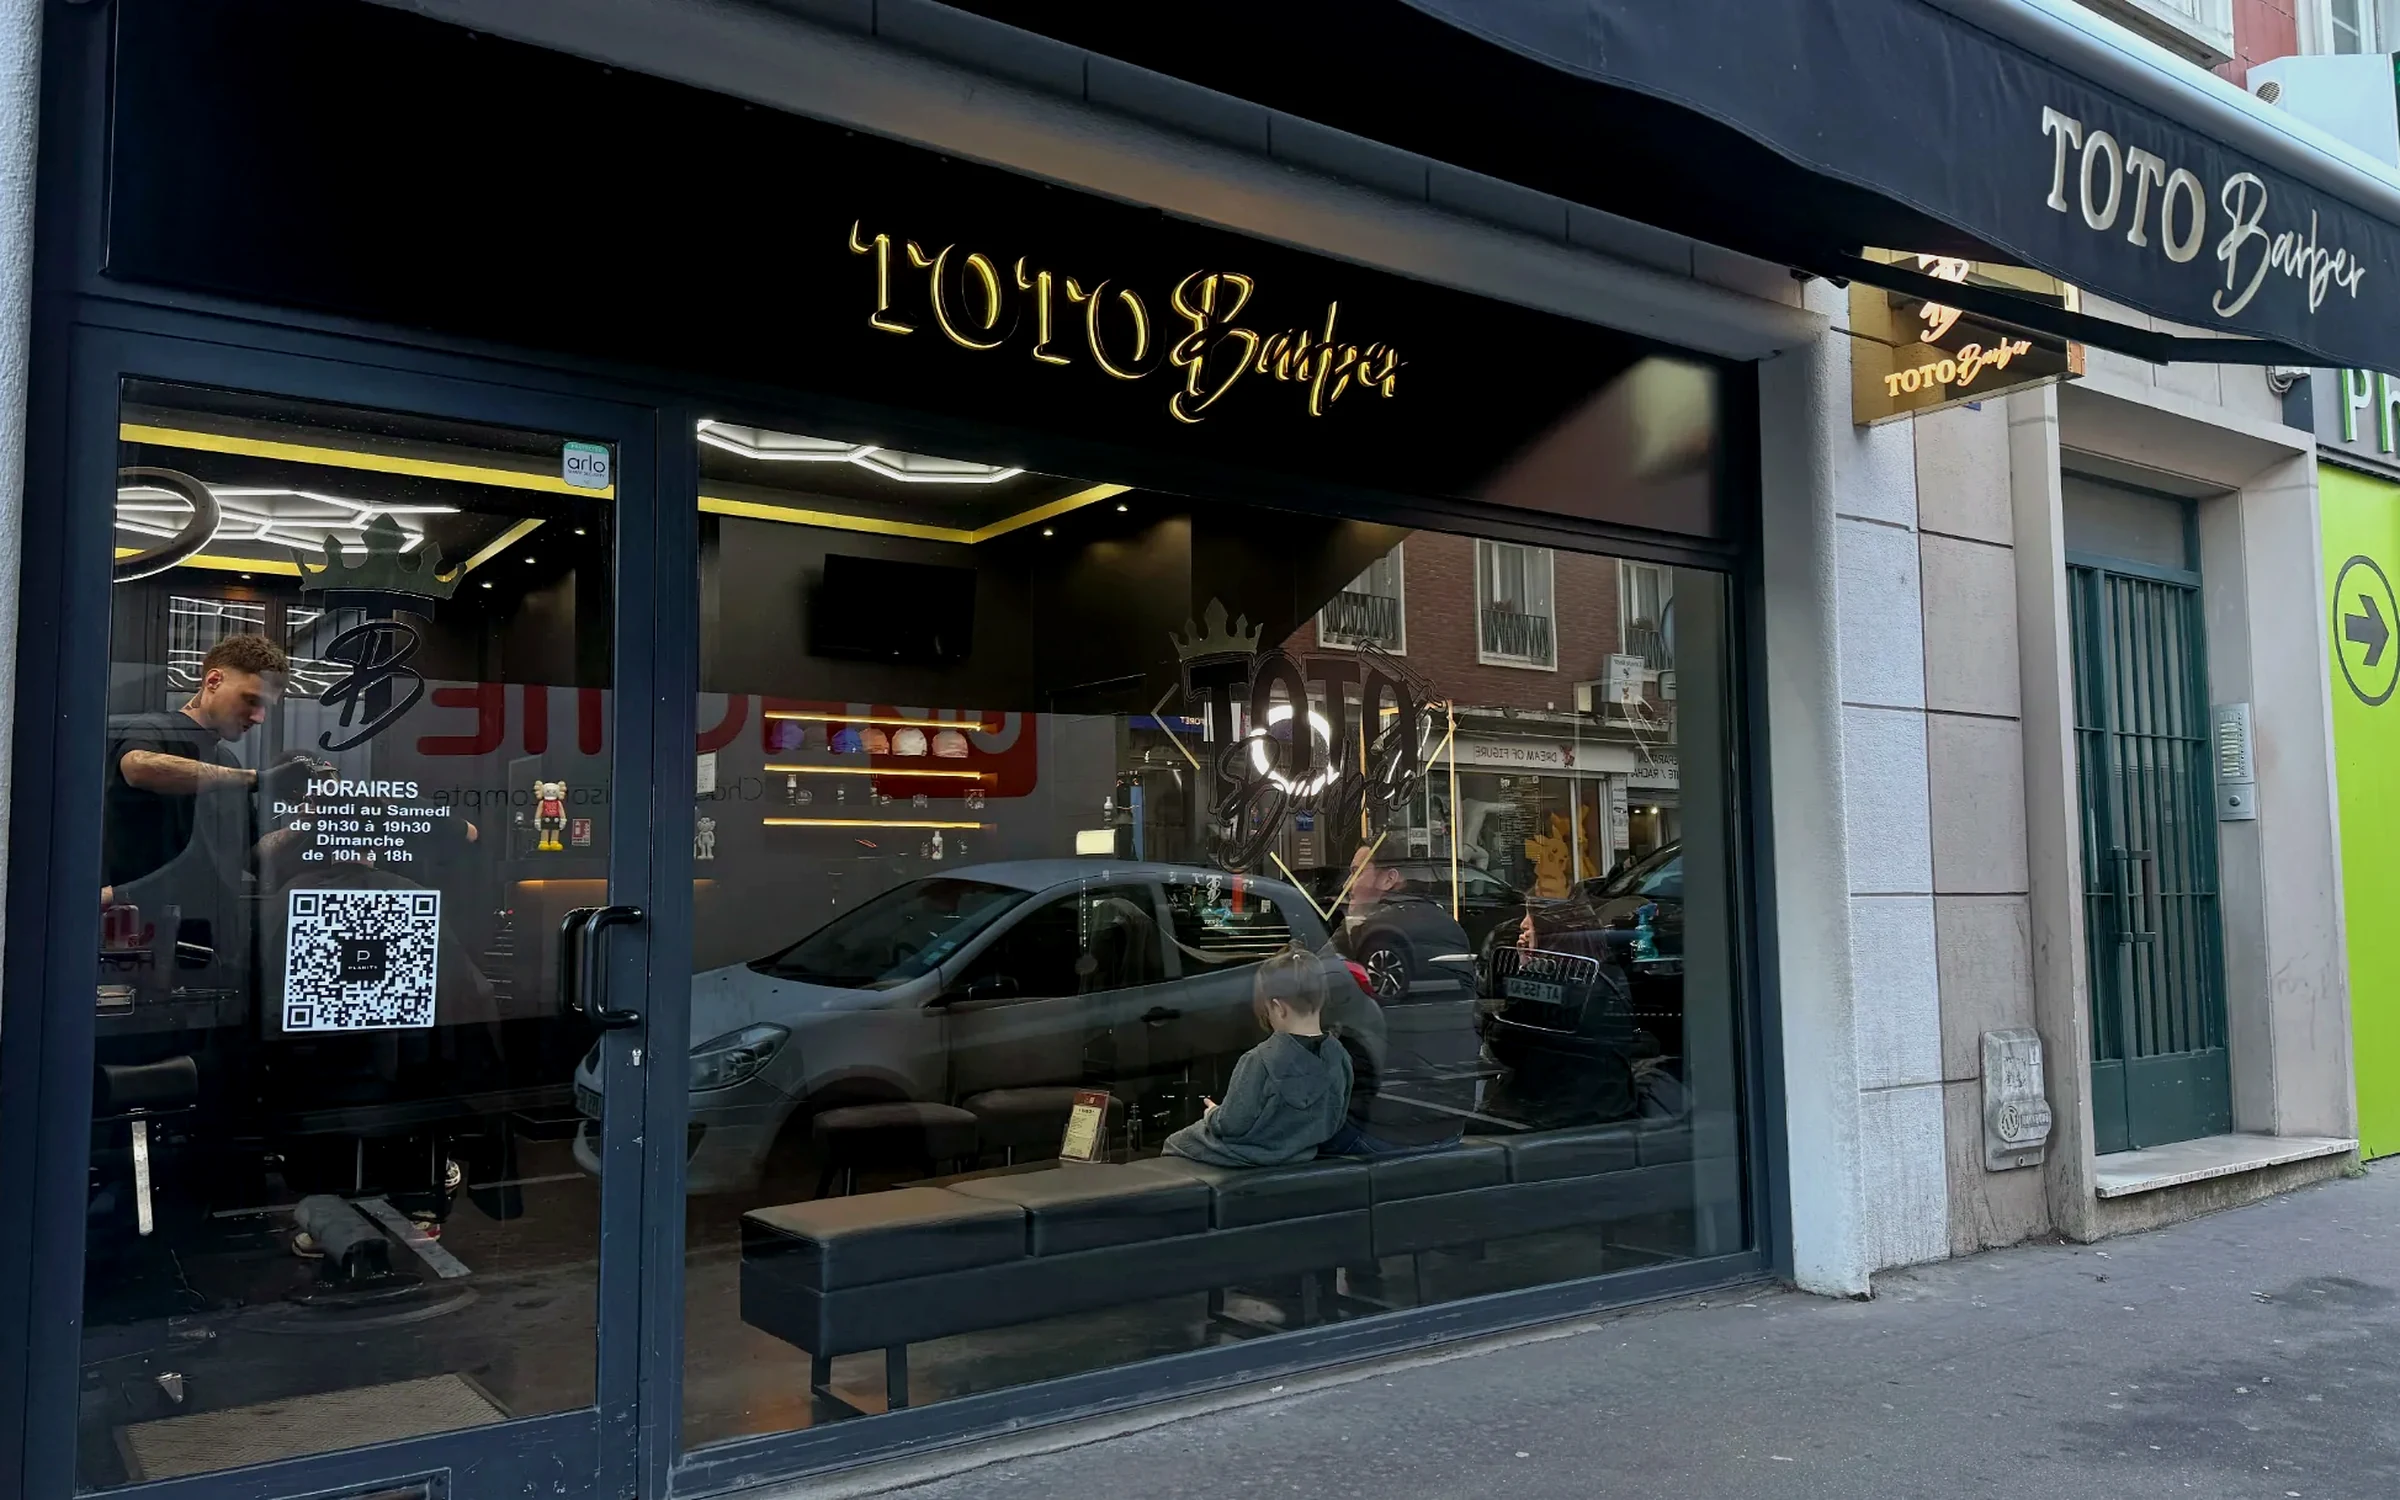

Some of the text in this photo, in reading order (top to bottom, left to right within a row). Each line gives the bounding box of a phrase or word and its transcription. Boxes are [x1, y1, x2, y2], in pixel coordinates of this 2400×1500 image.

[2042, 105, 2366, 318] TOTO Barber
[848, 219, 1408, 423] TOTO Barber
[1884, 337, 2032, 397] TOTO Barber
[567, 454, 606, 473] arlo
[306, 778, 419, 798] HORAIRES
[273, 802, 451, 817] Du Lundi au Samedi
[289, 820, 431, 833] de 9h30 à 19h30
[316, 834, 405, 847] Dimanche
[302, 849, 413, 862] de 10h à 18h
